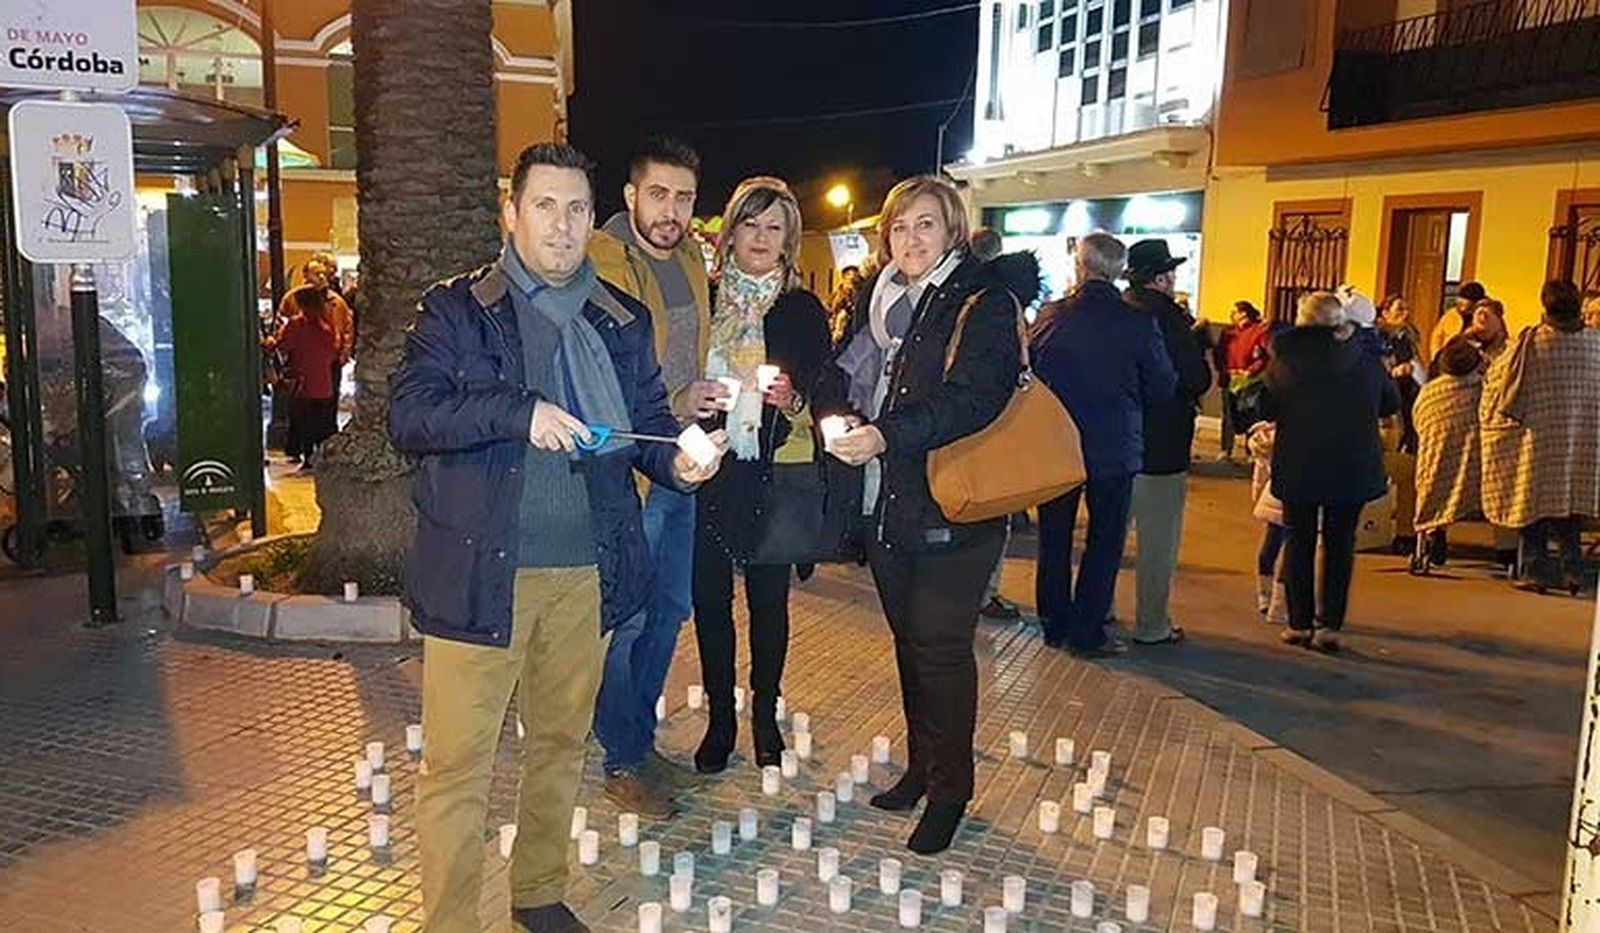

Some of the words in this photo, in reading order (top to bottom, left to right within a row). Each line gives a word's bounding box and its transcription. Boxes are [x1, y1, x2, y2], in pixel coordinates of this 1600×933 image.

[7, 28, 30, 42] DE
[36, 31, 88, 46] MAYO
[9, 47, 124, 75] Córdoba
